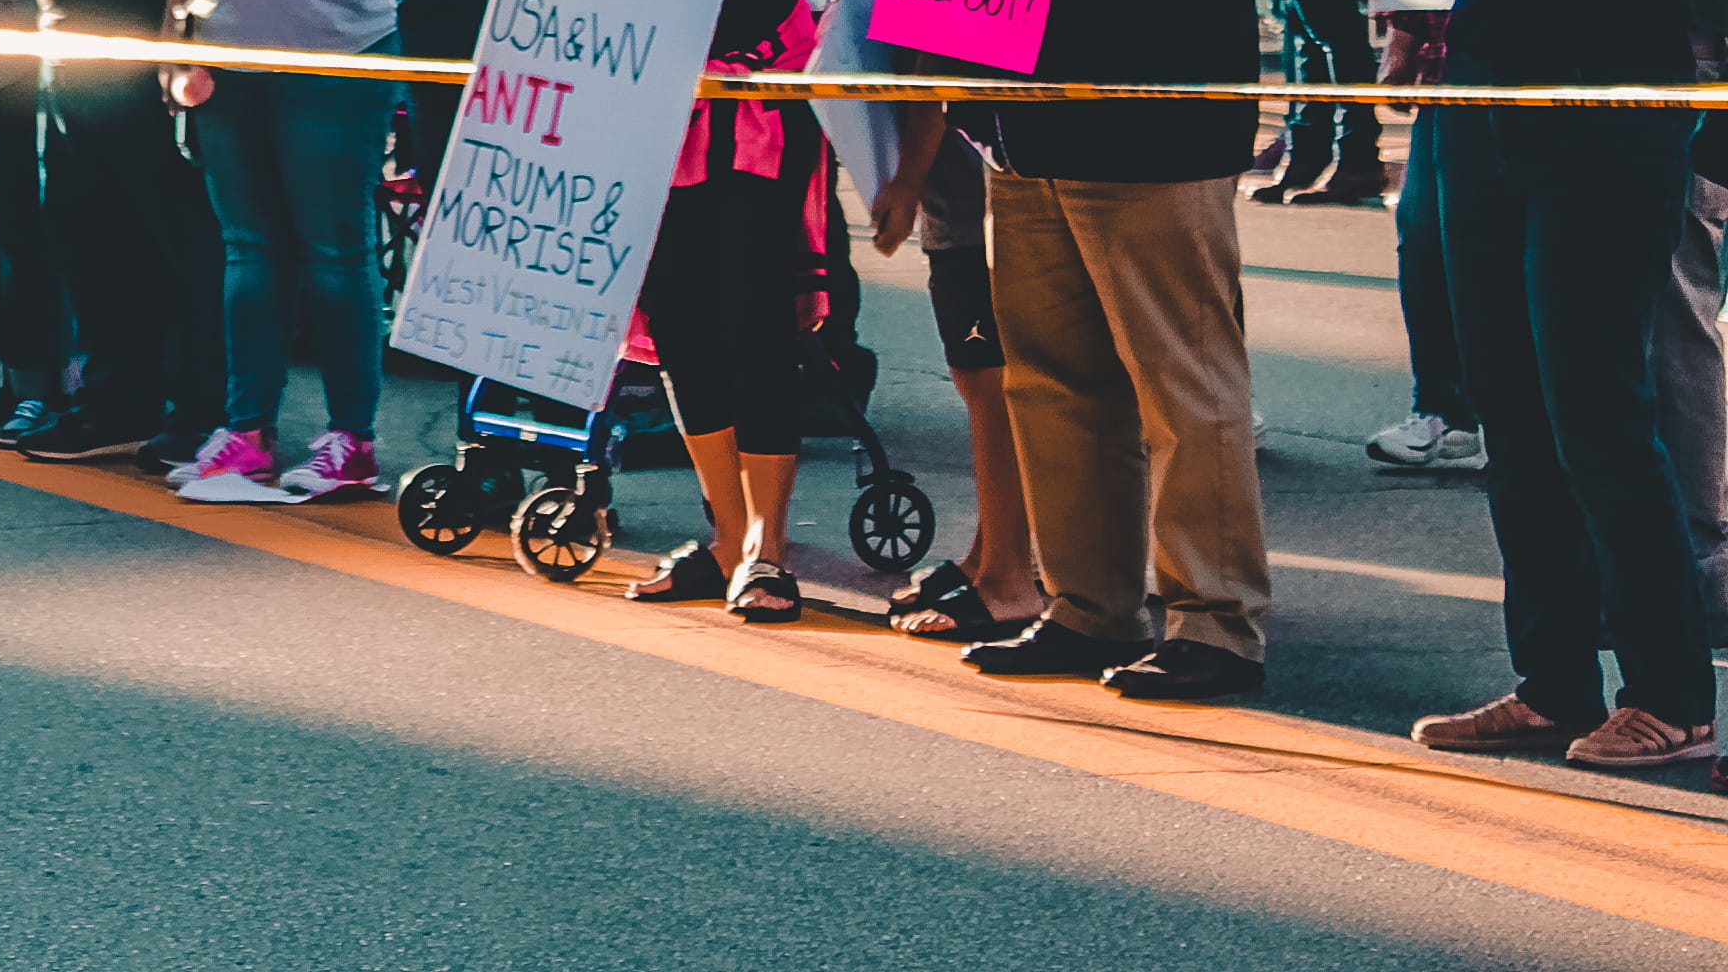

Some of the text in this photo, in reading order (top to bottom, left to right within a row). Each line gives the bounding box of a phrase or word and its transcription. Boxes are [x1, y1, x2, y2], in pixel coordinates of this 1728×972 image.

[465, 64, 574, 145] ANTI
[428, 187, 631, 296] MORRISEY
[493, 275, 620, 341] VIRGINIA
[480, 330, 541, 380] THE
